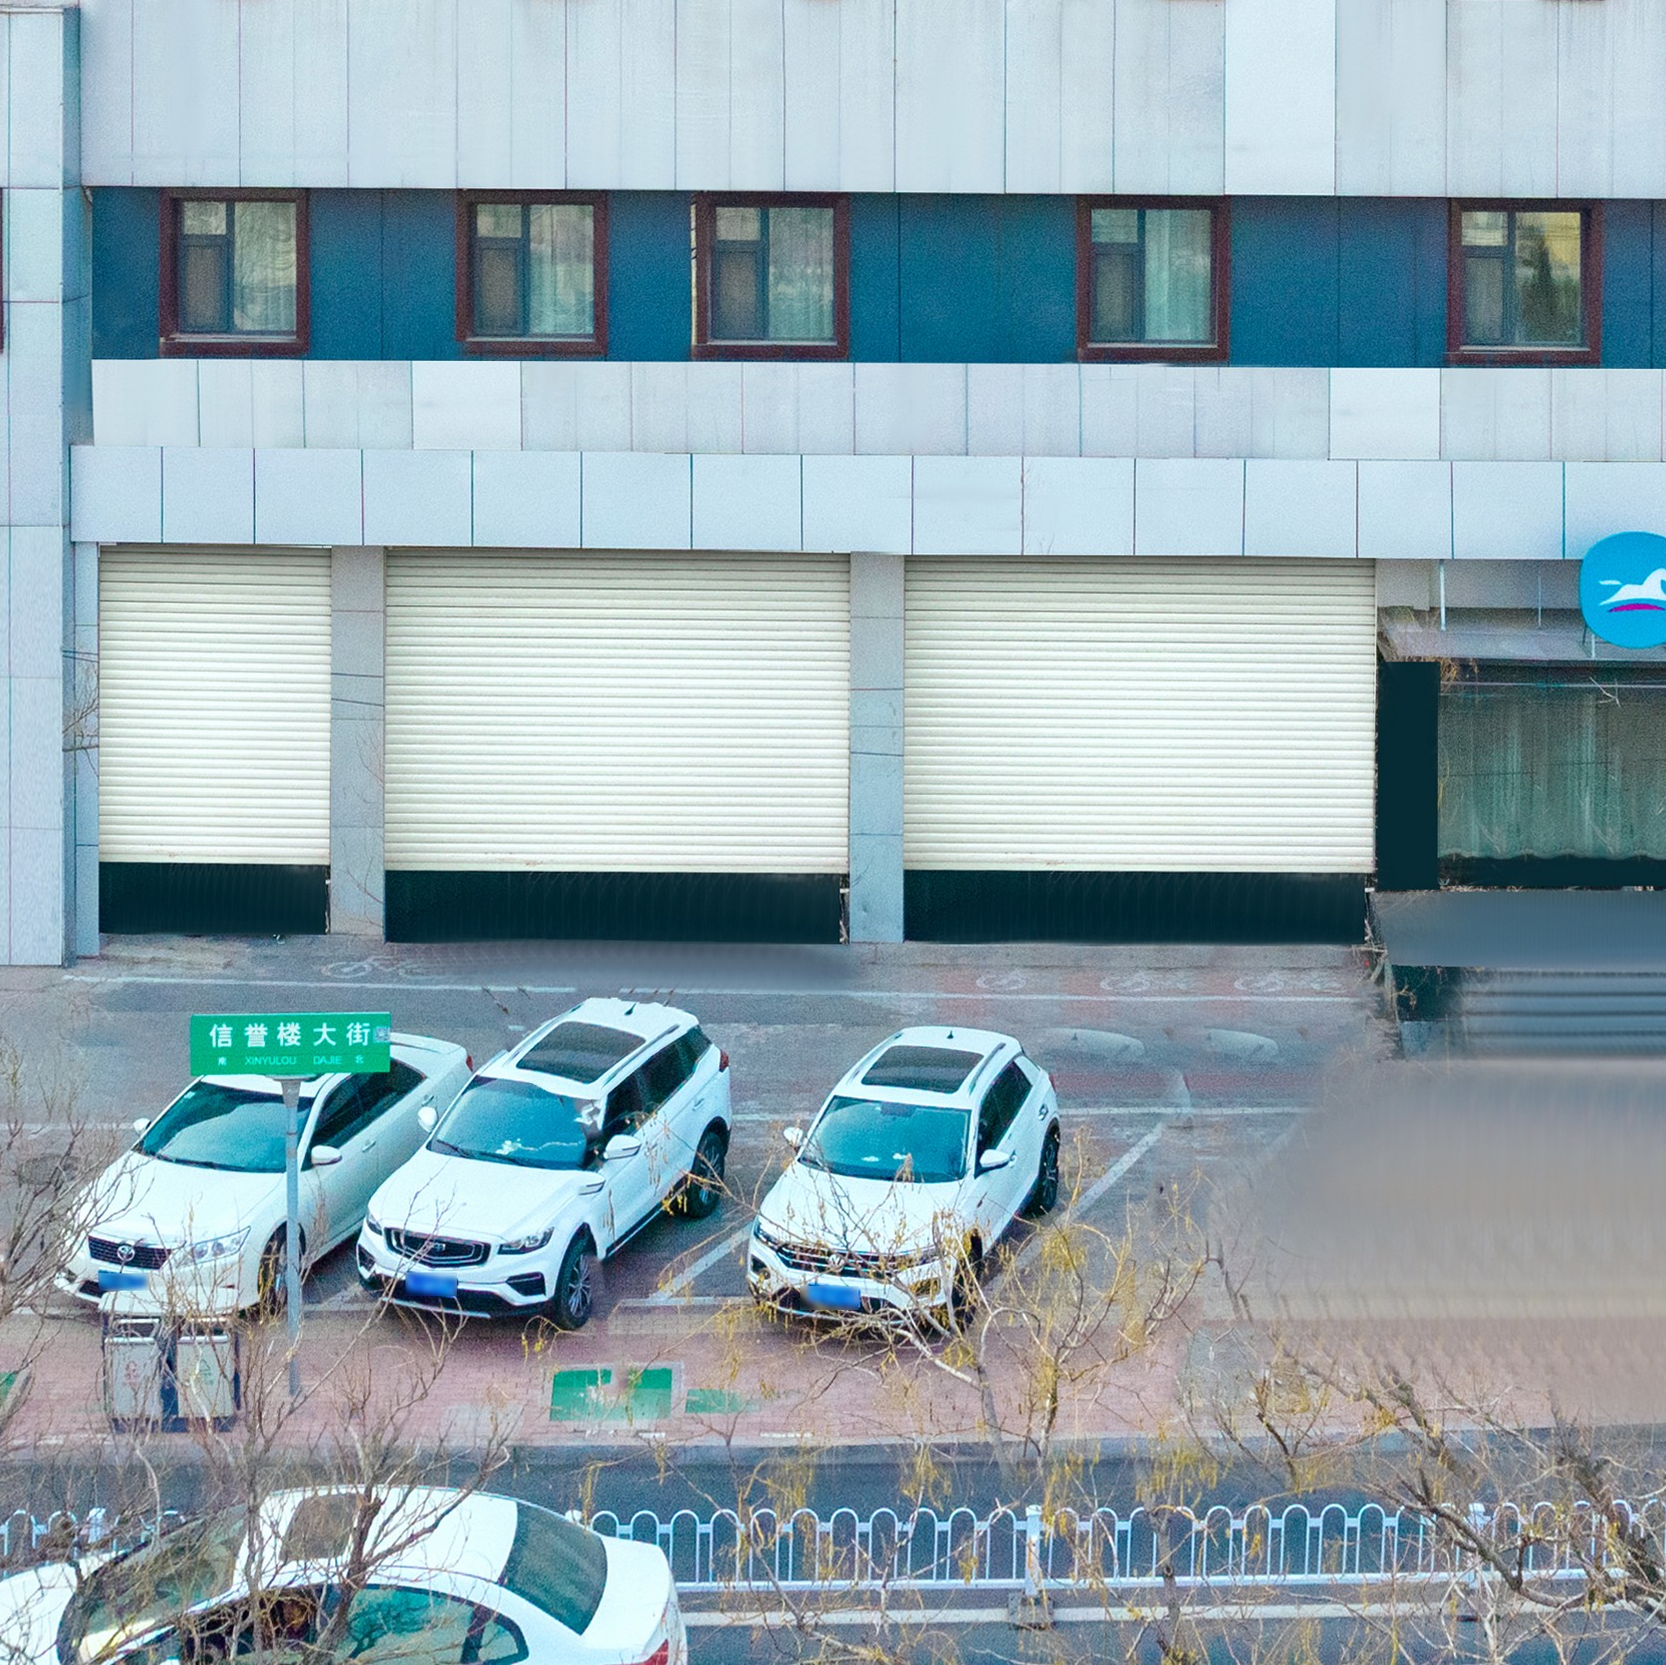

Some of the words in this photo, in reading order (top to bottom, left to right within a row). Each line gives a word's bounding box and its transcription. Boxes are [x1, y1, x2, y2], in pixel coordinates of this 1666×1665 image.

[209, 1021, 371, 1048] 信誉楼大街
[244, 1056, 298, 1066] XINYULOU
[313, 1055, 343, 1065] DAJIE
